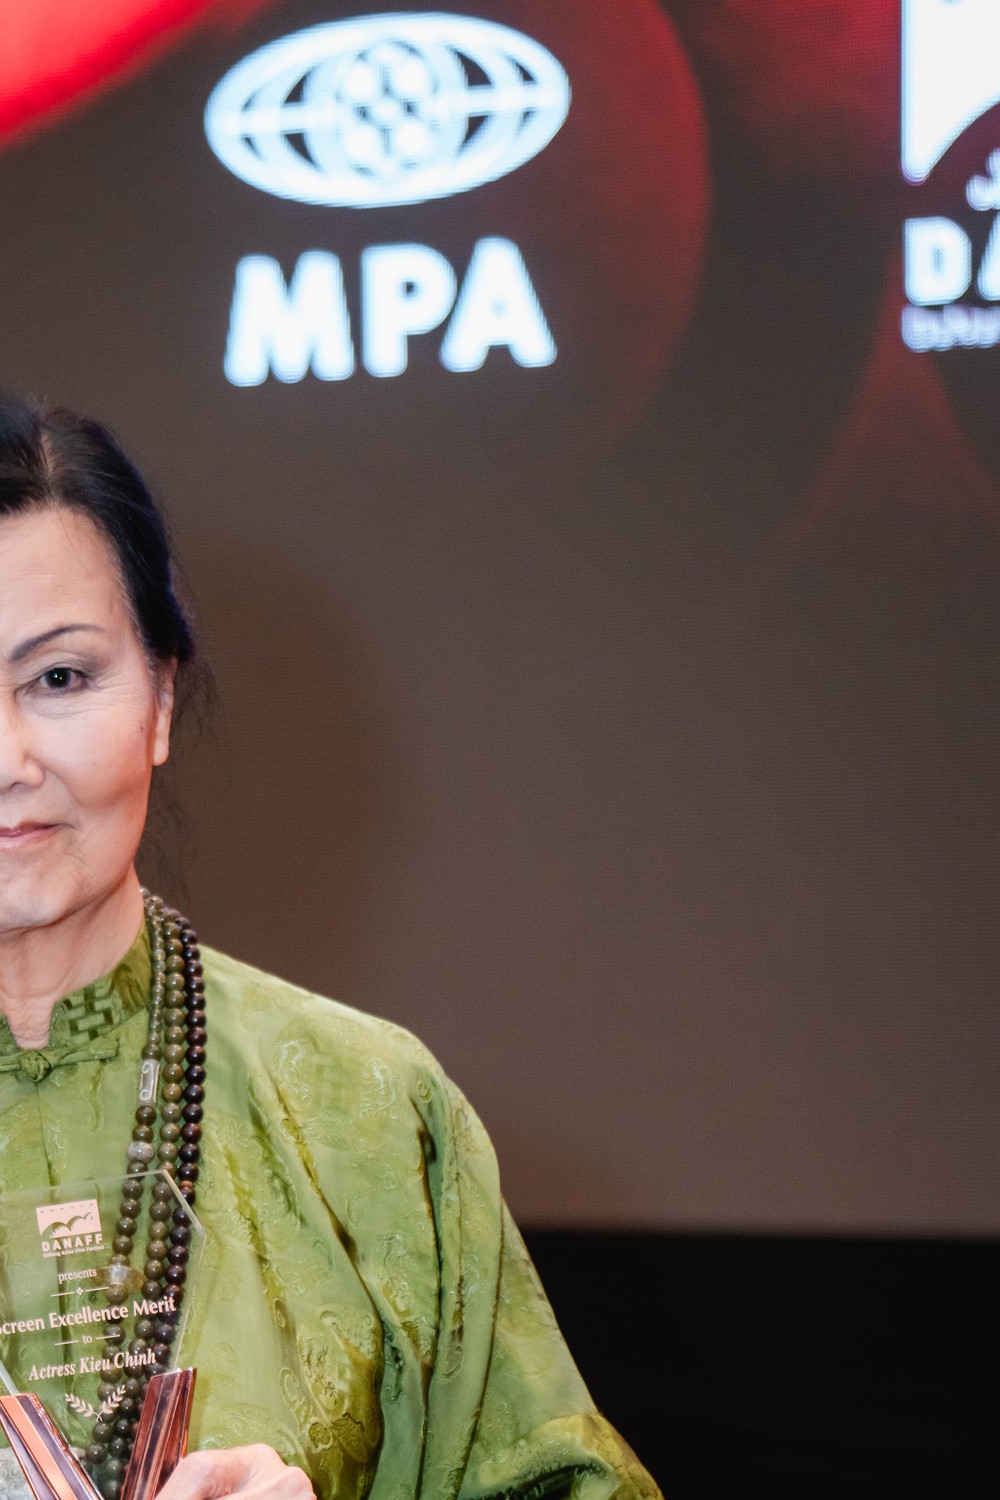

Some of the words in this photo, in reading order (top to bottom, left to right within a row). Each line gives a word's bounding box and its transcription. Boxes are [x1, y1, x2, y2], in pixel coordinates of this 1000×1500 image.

[224, 236, 558, 387] MPA
[41, 1233, 103, 1252] DANAFF
[58, 1268, 97, 1285] presents
[48, 1306, 129, 1329] Excellence
[133, 1295, 177, 1317] Merit
[82, 1335, 93, 1345] to
[28, 1363, 76, 1381] Actress
[79, 1356, 111, 1374] Kieu
[113, 1348, 157, 1370] Chinh
